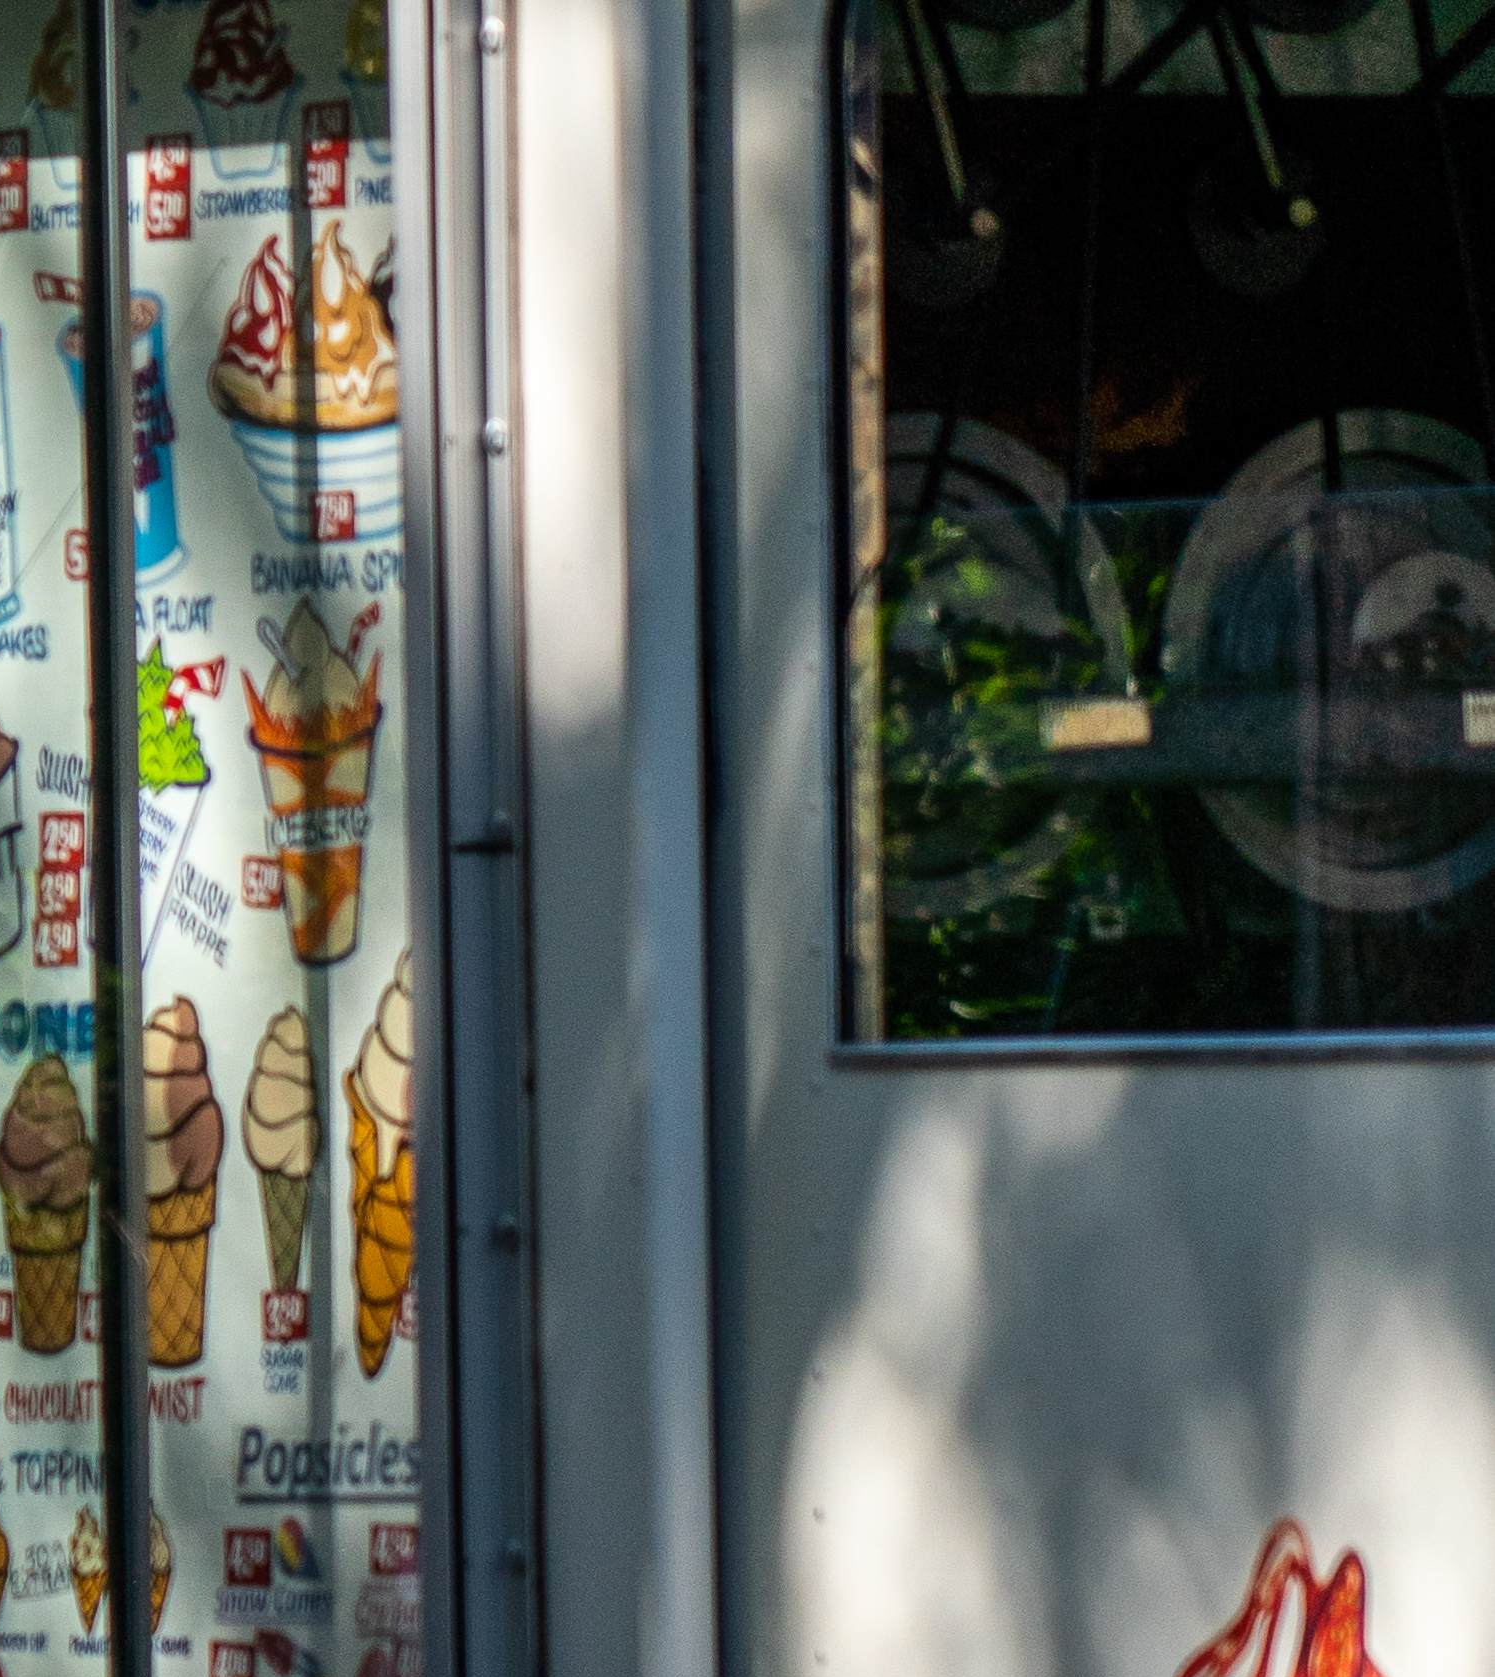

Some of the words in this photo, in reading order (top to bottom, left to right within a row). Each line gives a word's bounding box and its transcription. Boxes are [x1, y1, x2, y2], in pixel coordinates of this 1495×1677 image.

[251, 551, 355, 593] BANANA
[154, 595, 214, 632] FLOAT
[263, 807, 370, 853] ICEBERG
[238, 1420, 420, 1499] Popsicles
